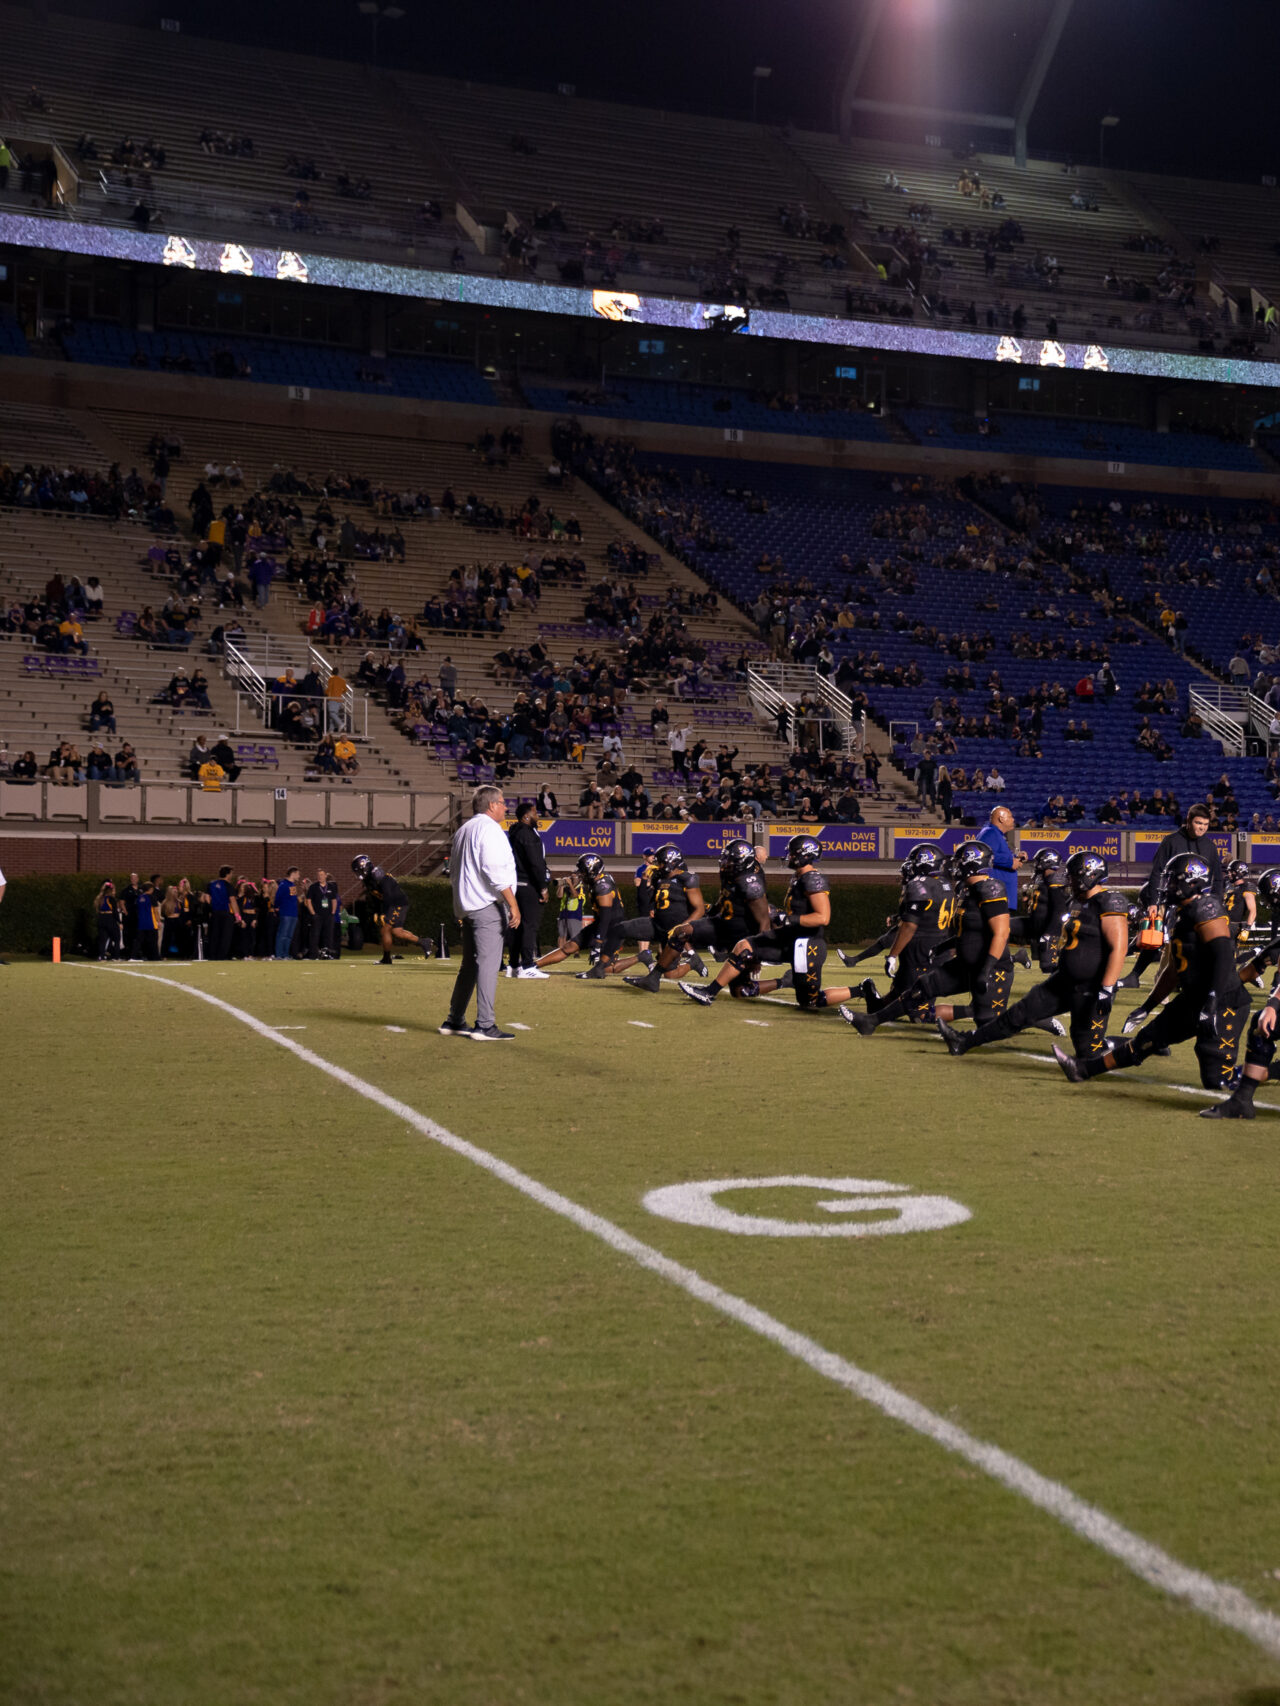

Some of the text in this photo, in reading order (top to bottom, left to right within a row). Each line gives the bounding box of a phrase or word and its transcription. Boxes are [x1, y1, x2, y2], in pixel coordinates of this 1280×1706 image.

[277, 789, 286, 799] 14
[591, 827, 612, 836] LOU
[756, 823, 764, 832] 15
[776, 826, 810, 834] 1963-1965
[722, 829, 743, 838] BILL
[851, 832, 876, 841] DAVE
[555, 837, 612, 848] HALLOW
[1103, 837, 1118, 845] JIM
[641, 1174, 974, 1238] G
